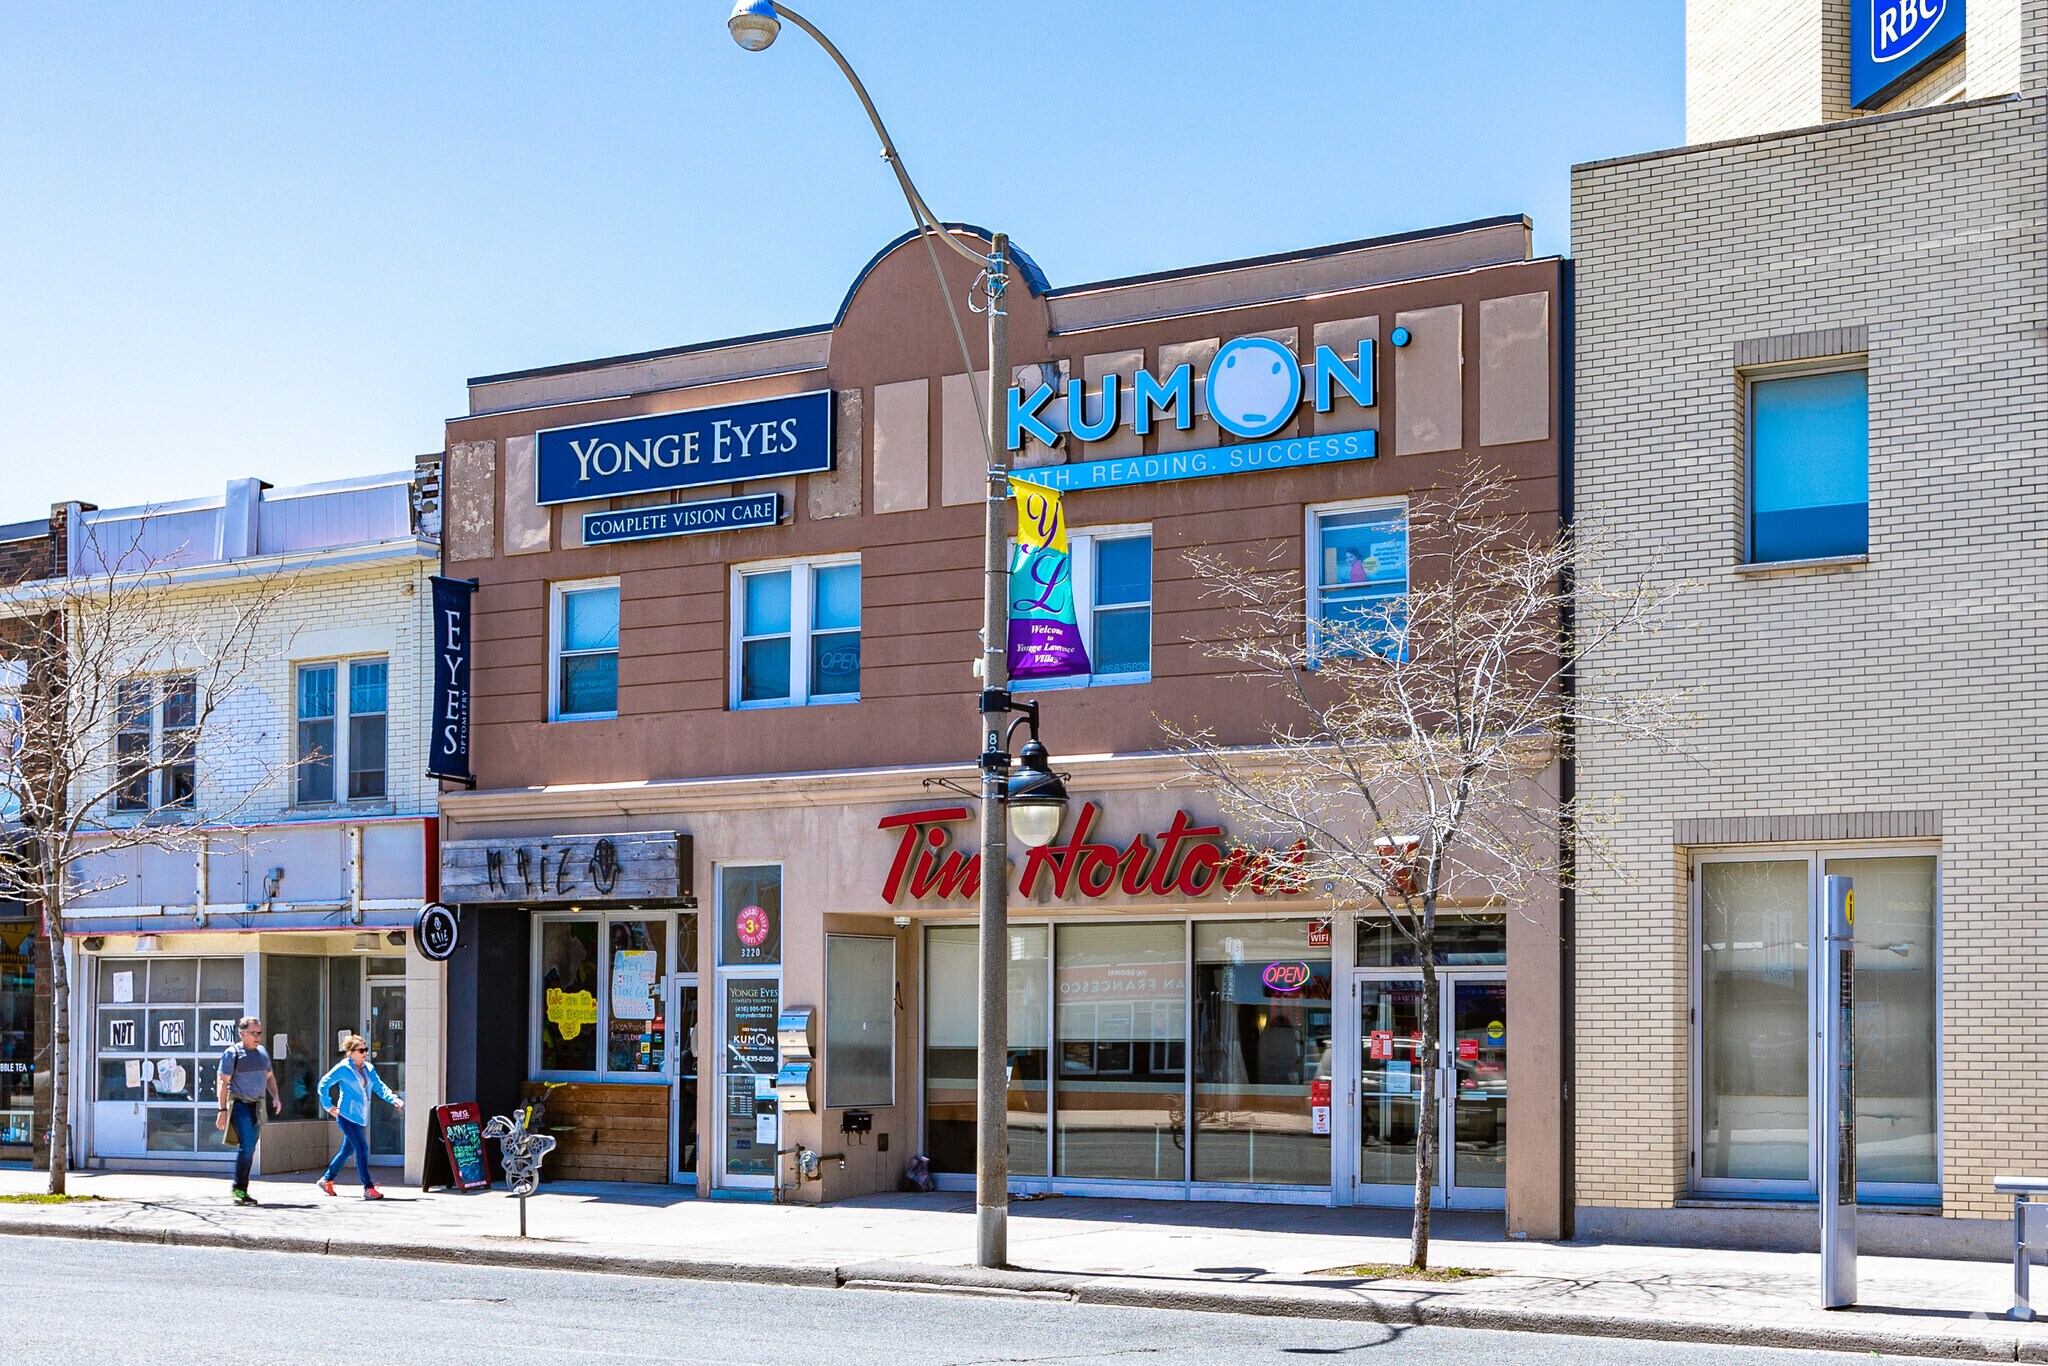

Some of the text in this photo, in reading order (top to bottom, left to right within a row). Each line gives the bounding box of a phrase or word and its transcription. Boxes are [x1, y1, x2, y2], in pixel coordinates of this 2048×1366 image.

[1880, 0, 1938, 50] RBC
[1006, 335, 1378, 451] KUMON
[569, 418, 798, 481] YONGE EYES
[1014, 436, 1369, 487] ATH. READING. SUCCESS.
[590, 502, 772, 536] COMPLETE VISION CARE
[820, 652, 861, 669] OPEN
[1016, 643, 1042, 653] Yonge
[443, 609, 464, 755] EYES
[460, 689, 468, 755] OPTOMETRY
[876, 801, 1307, 905] Tim Hortons
[1265, 966, 1306, 983] OPEN
[730, 988, 759, 998] YONGE
[161, 1022, 184, 1045] OPEN
[733, 1033, 775, 1047] KUMON
[15, 1062, 28, 1072] TEA
